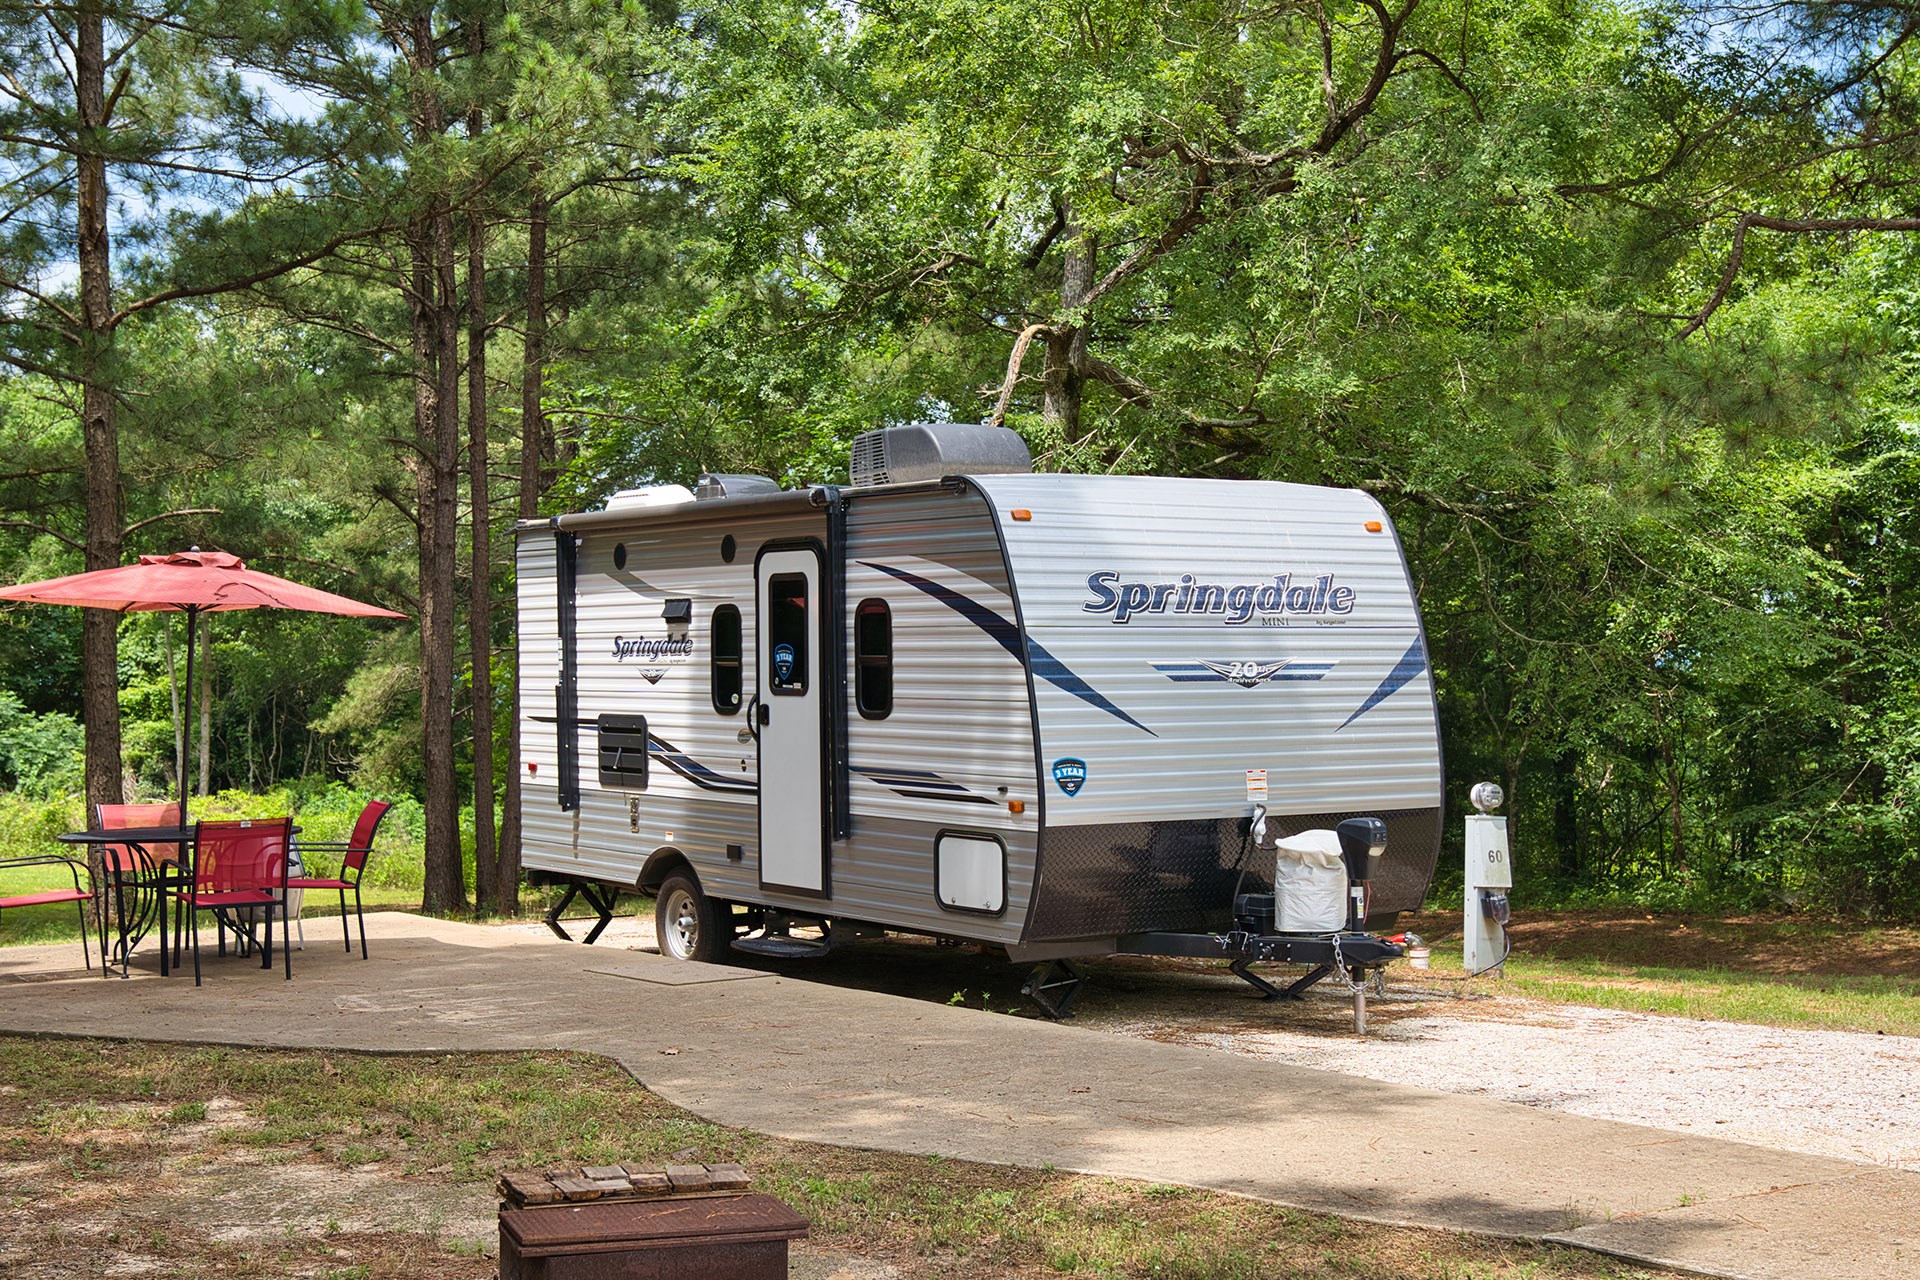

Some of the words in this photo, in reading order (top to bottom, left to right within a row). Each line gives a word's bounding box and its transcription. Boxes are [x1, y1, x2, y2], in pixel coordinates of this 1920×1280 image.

[1082, 569, 1356, 624] Springdale
[1262, 617, 1289, 626] MINI
[612, 632, 693, 662] Springdale
[1055, 769, 1061, 778] 3
[1062, 767, 1084, 776] YEAR
[1488, 850, 1503, 863] 60
